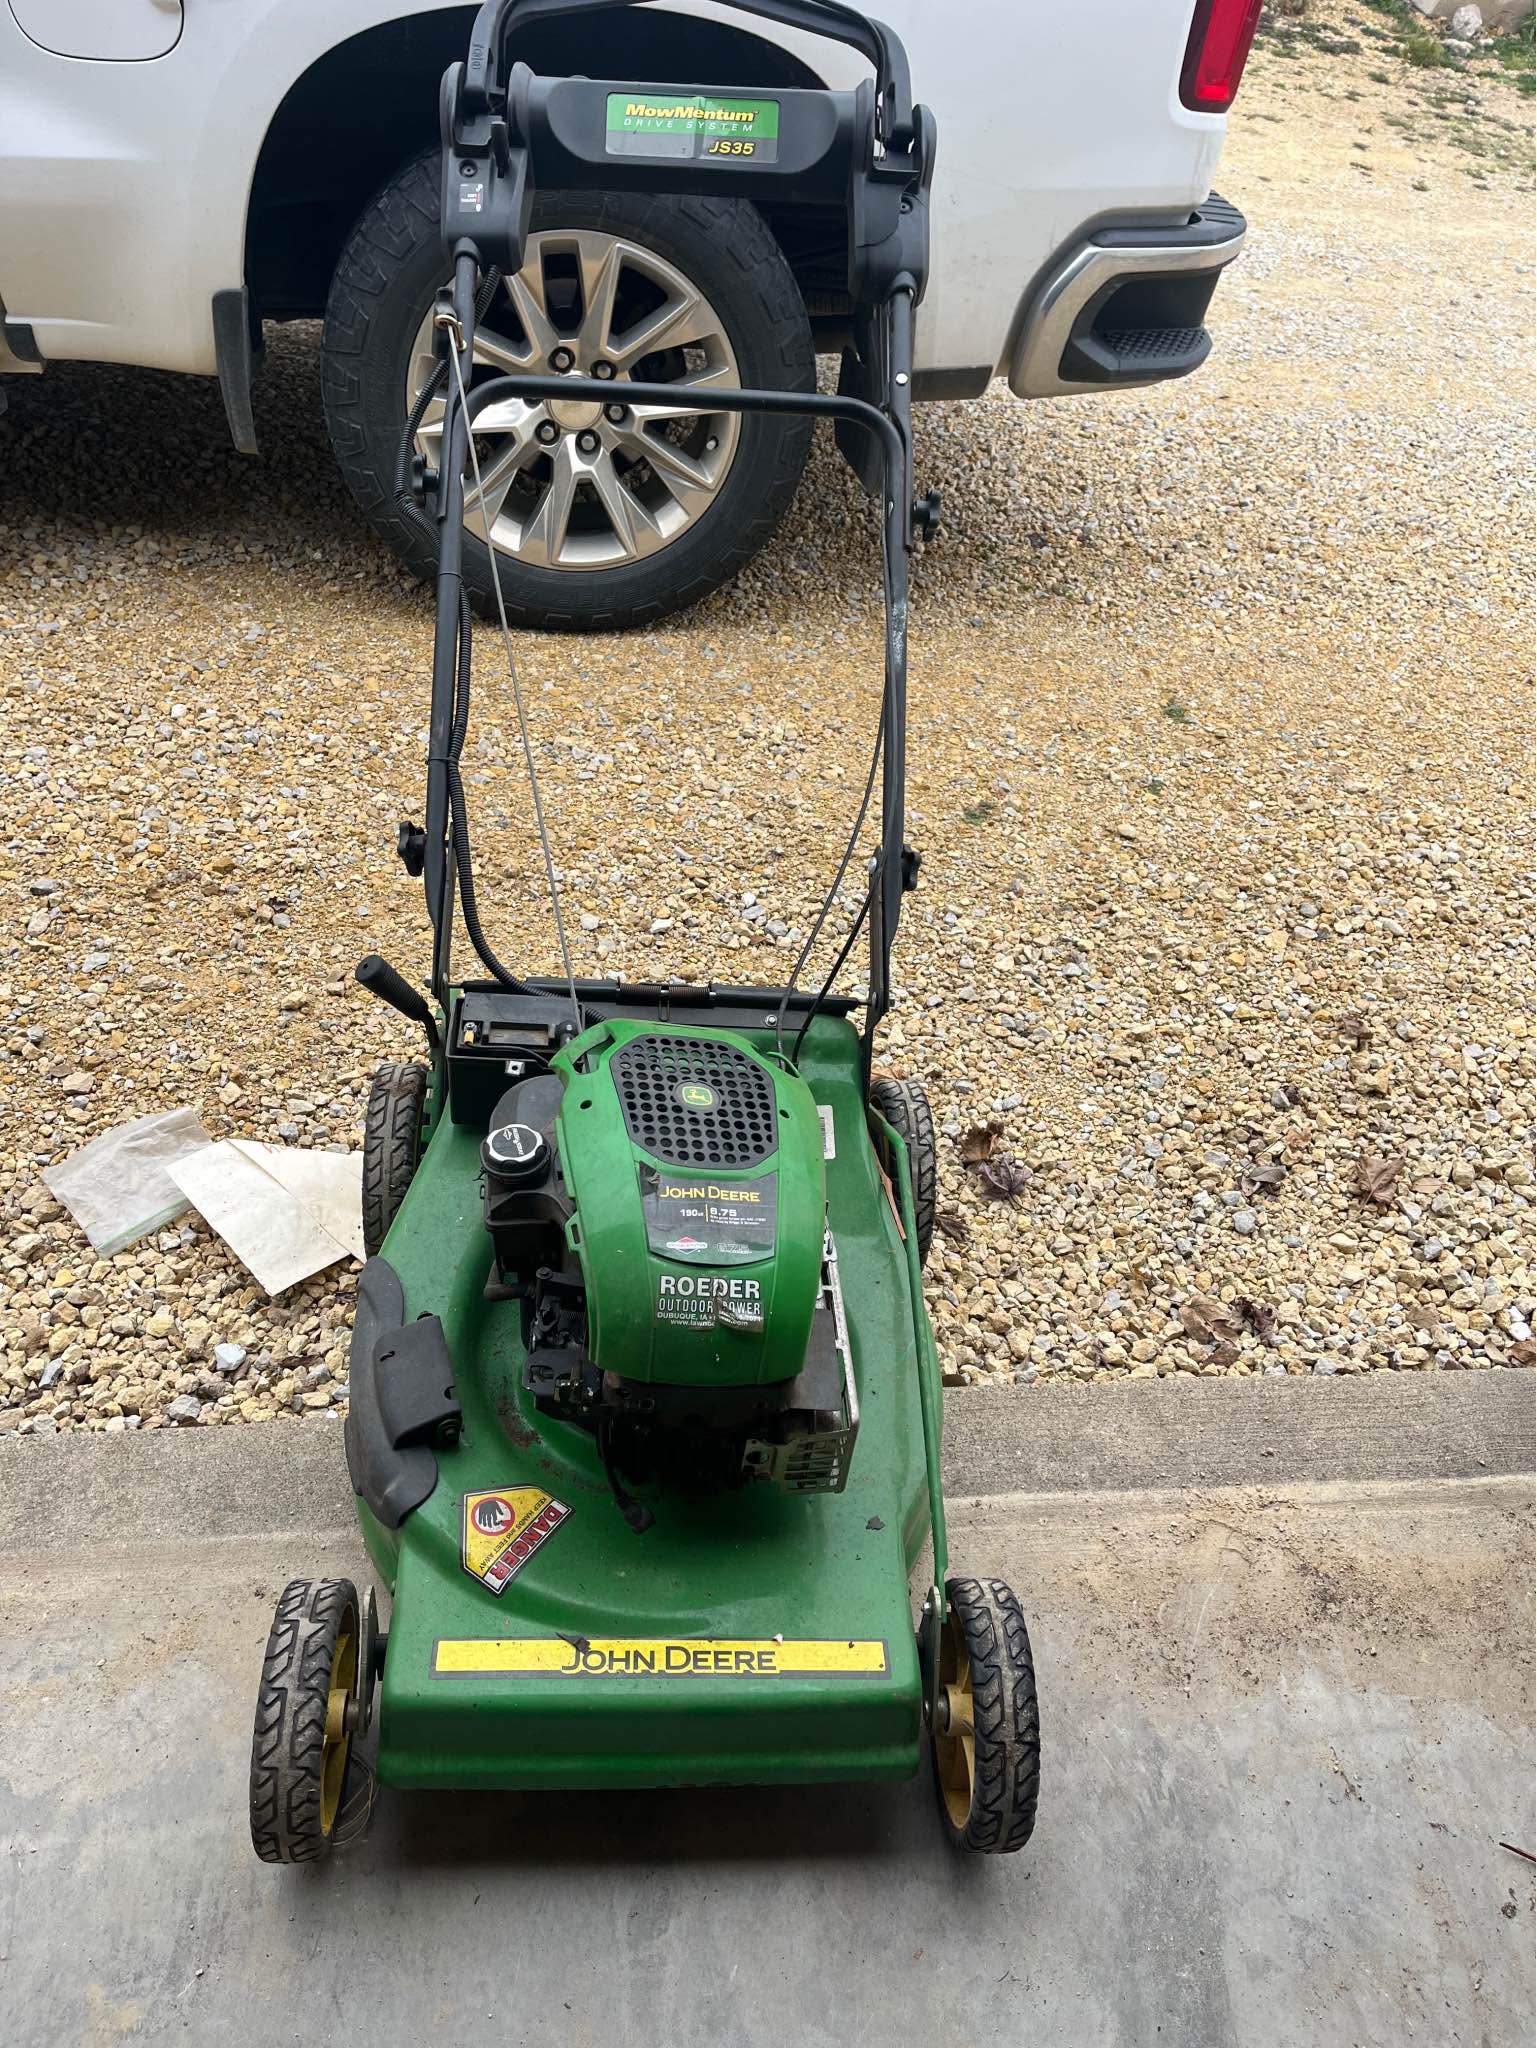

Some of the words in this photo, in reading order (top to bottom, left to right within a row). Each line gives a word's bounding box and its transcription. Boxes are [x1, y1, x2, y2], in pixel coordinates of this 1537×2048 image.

[624, 103, 756, 122] MowMentum
[623, 118, 674, 128] DRIVE
[685, 121, 753, 132] SYSTEM
[708, 140, 755, 156] JS35
[659, 1185, 705, 1199] JOHN
[707, 1185, 761, 1202] DEERE
[660, 1275, 760, 1299] ROEDER
[659, 1297, 714, 1313] OUTDOOR
[534, 1496, 547, 1509] KEEP
[516, 1510, 535, 1529] HANDS
[508, 1528, 517, 1538] and
[489, 1505, 563, 1581] DANGER
[494, 1539, 509, 1554] FEET
[479, 1552, 495, 1571] AWAY
[561, 1647, 655, 1671] JOHN
[665, 1645, 777, 1671] DEERE
